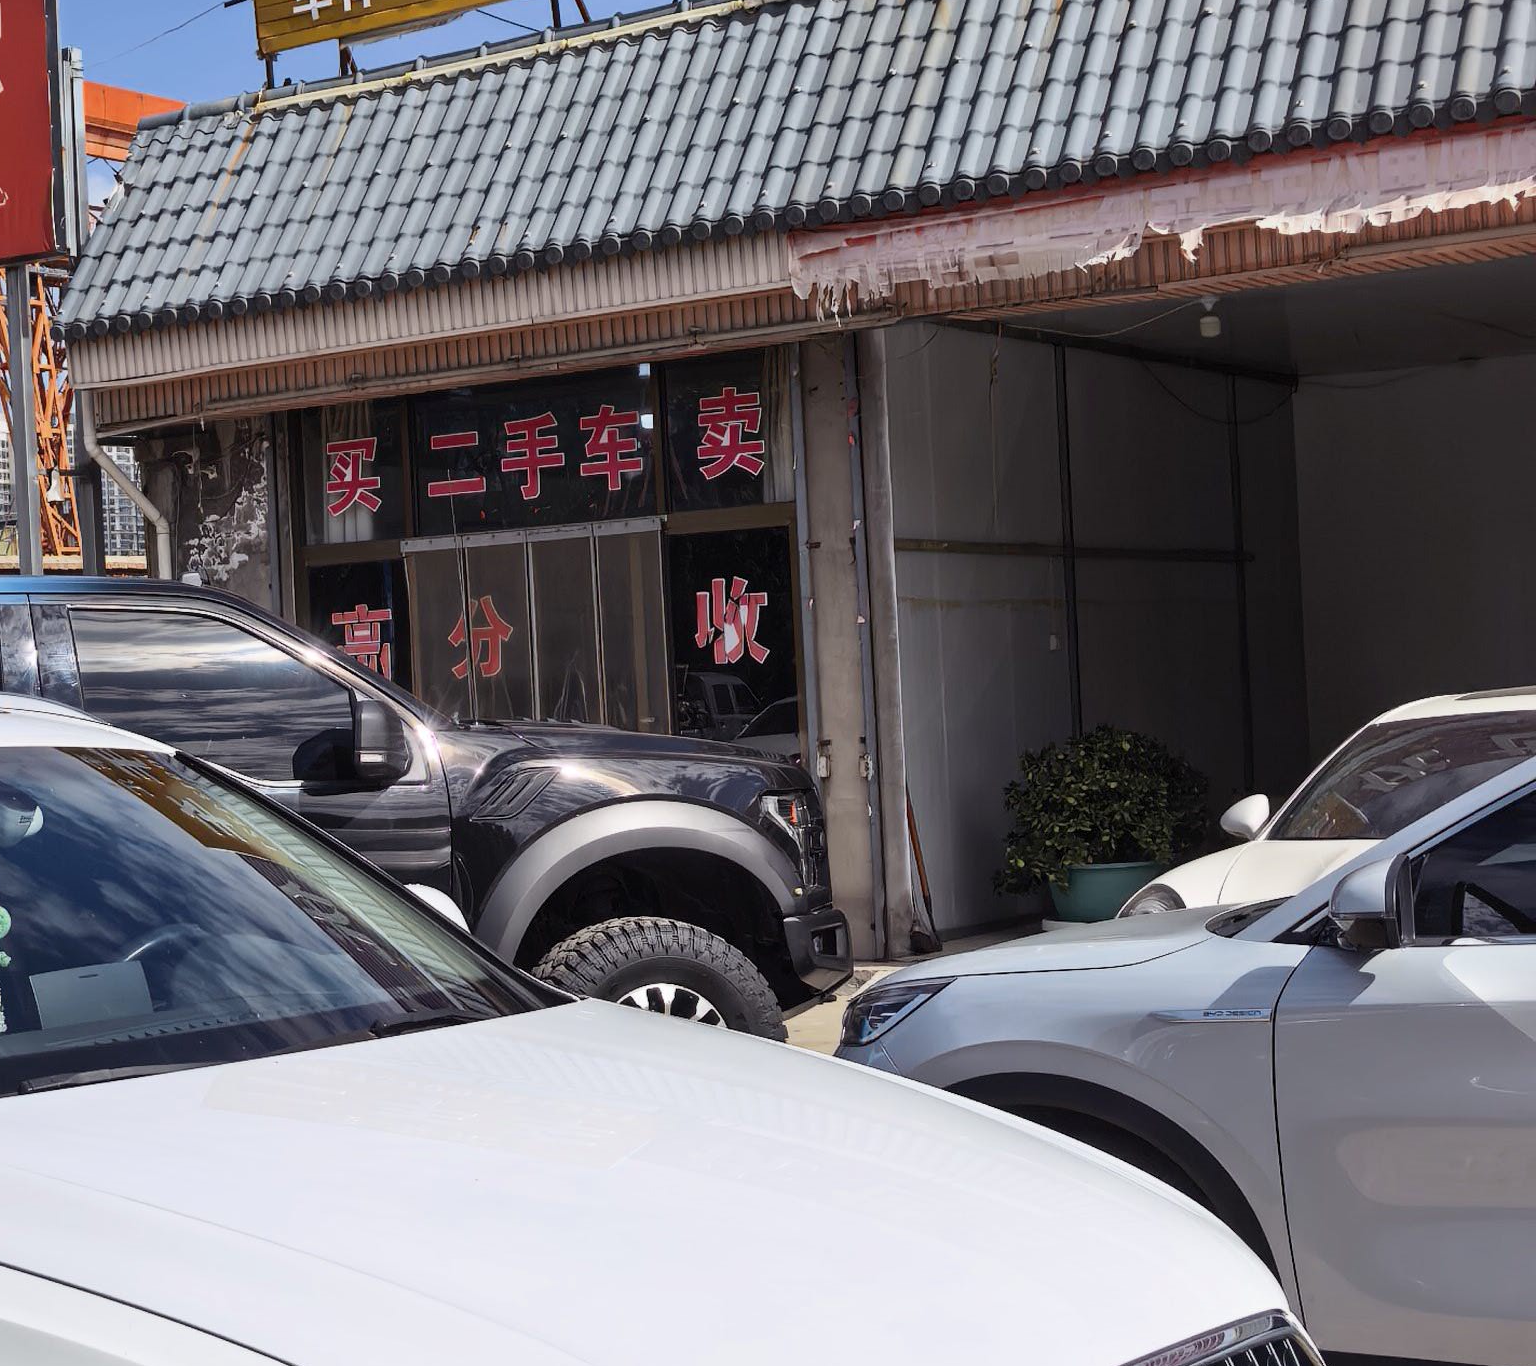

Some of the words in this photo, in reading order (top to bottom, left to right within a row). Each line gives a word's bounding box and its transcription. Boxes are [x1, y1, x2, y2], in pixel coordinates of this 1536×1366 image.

[326, 437, 382, 517] 买
[427, 403, 643, 501] 二手车
[696, 386, 765, 481] 卖
